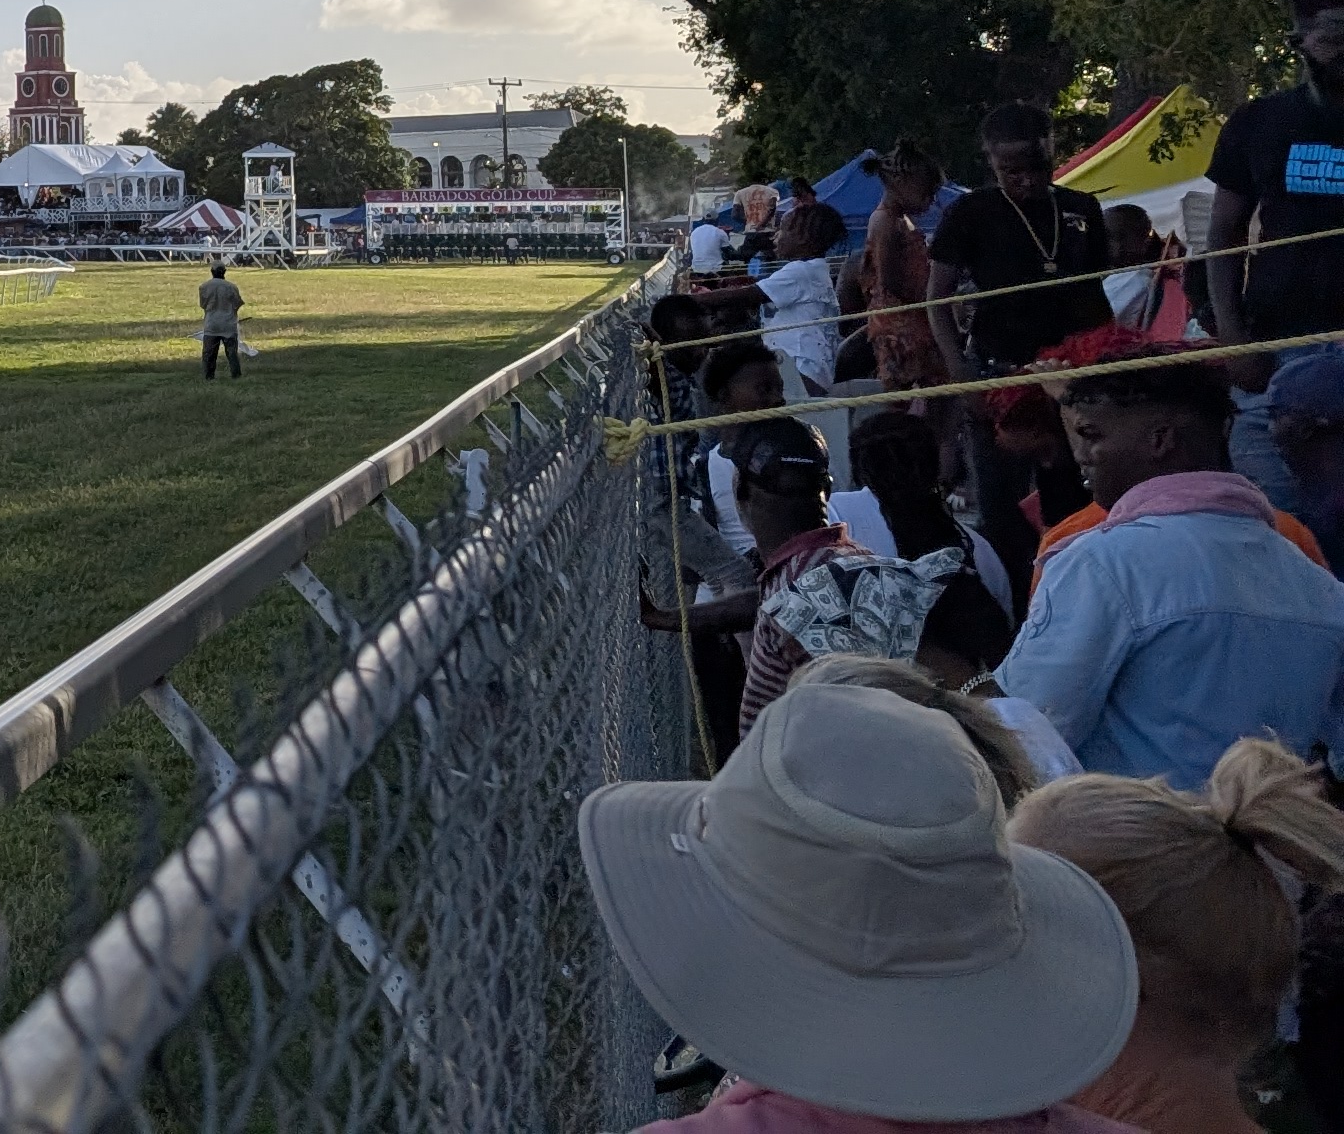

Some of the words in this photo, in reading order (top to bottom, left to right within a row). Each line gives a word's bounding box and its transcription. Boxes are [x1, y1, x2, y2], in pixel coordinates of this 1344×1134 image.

[401, 190, 477, 202] BARBADOS
[480, 190, 523, 201] GOLD
[526, 189, 557, 201] CUP
